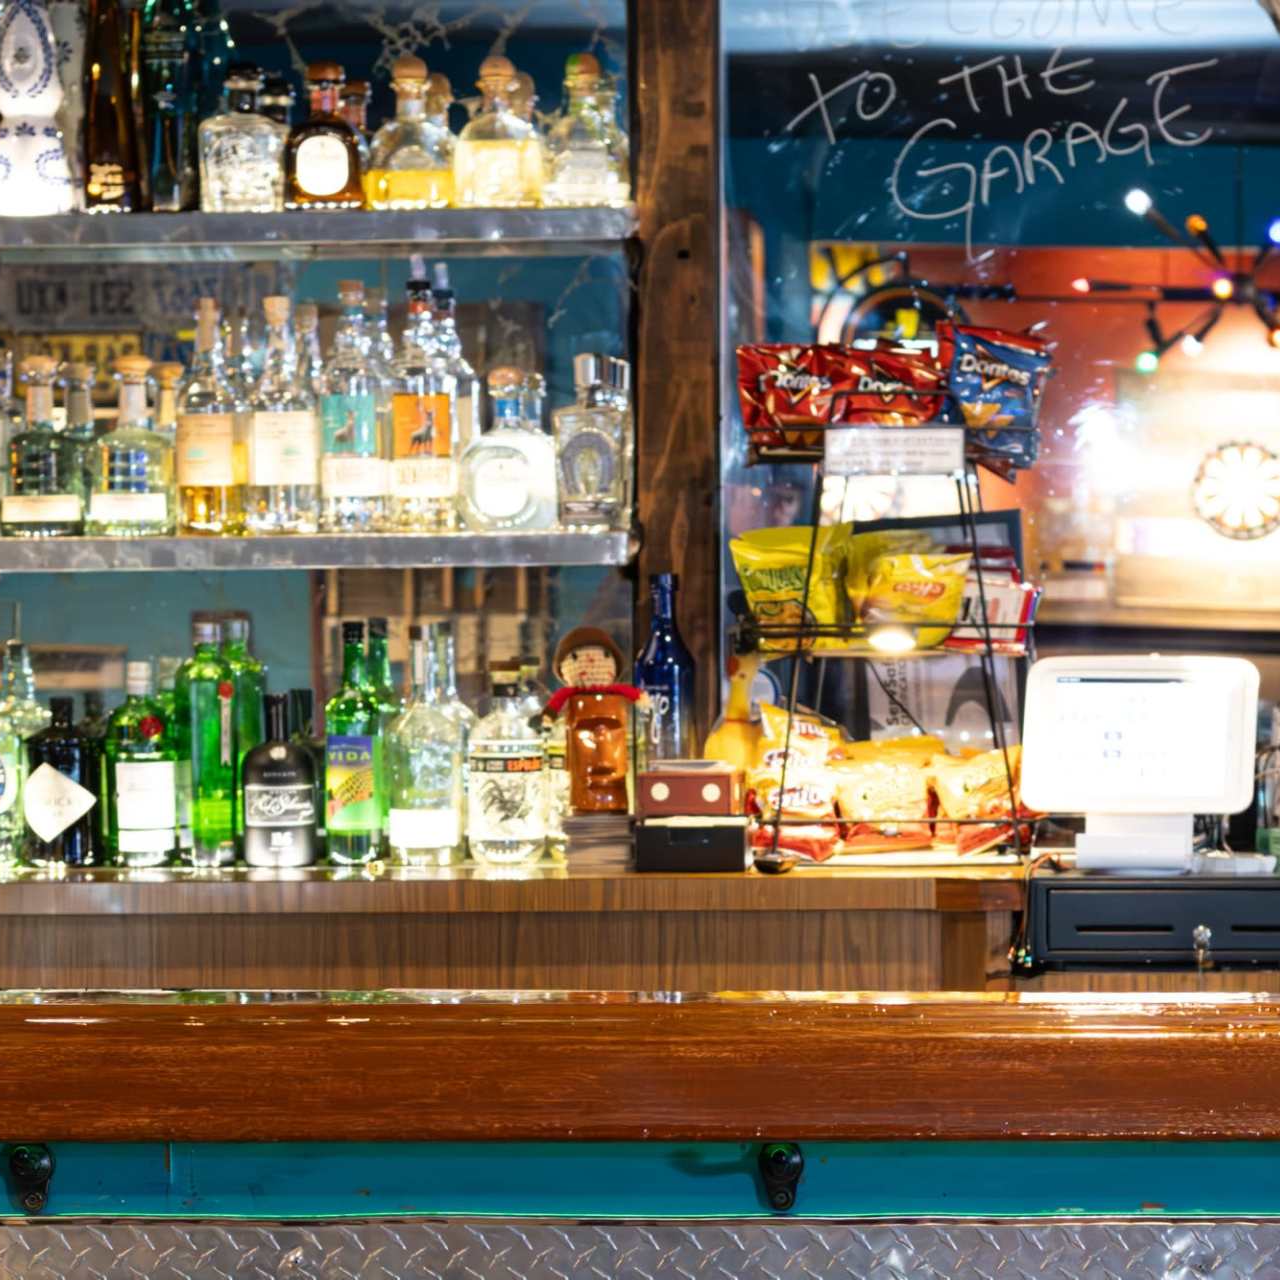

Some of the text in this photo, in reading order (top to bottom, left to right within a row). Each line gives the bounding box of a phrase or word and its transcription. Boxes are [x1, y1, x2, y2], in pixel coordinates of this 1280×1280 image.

[788, 47, 1095, 144] TO THE
[892, 58, 1219, 262] GARAGE
